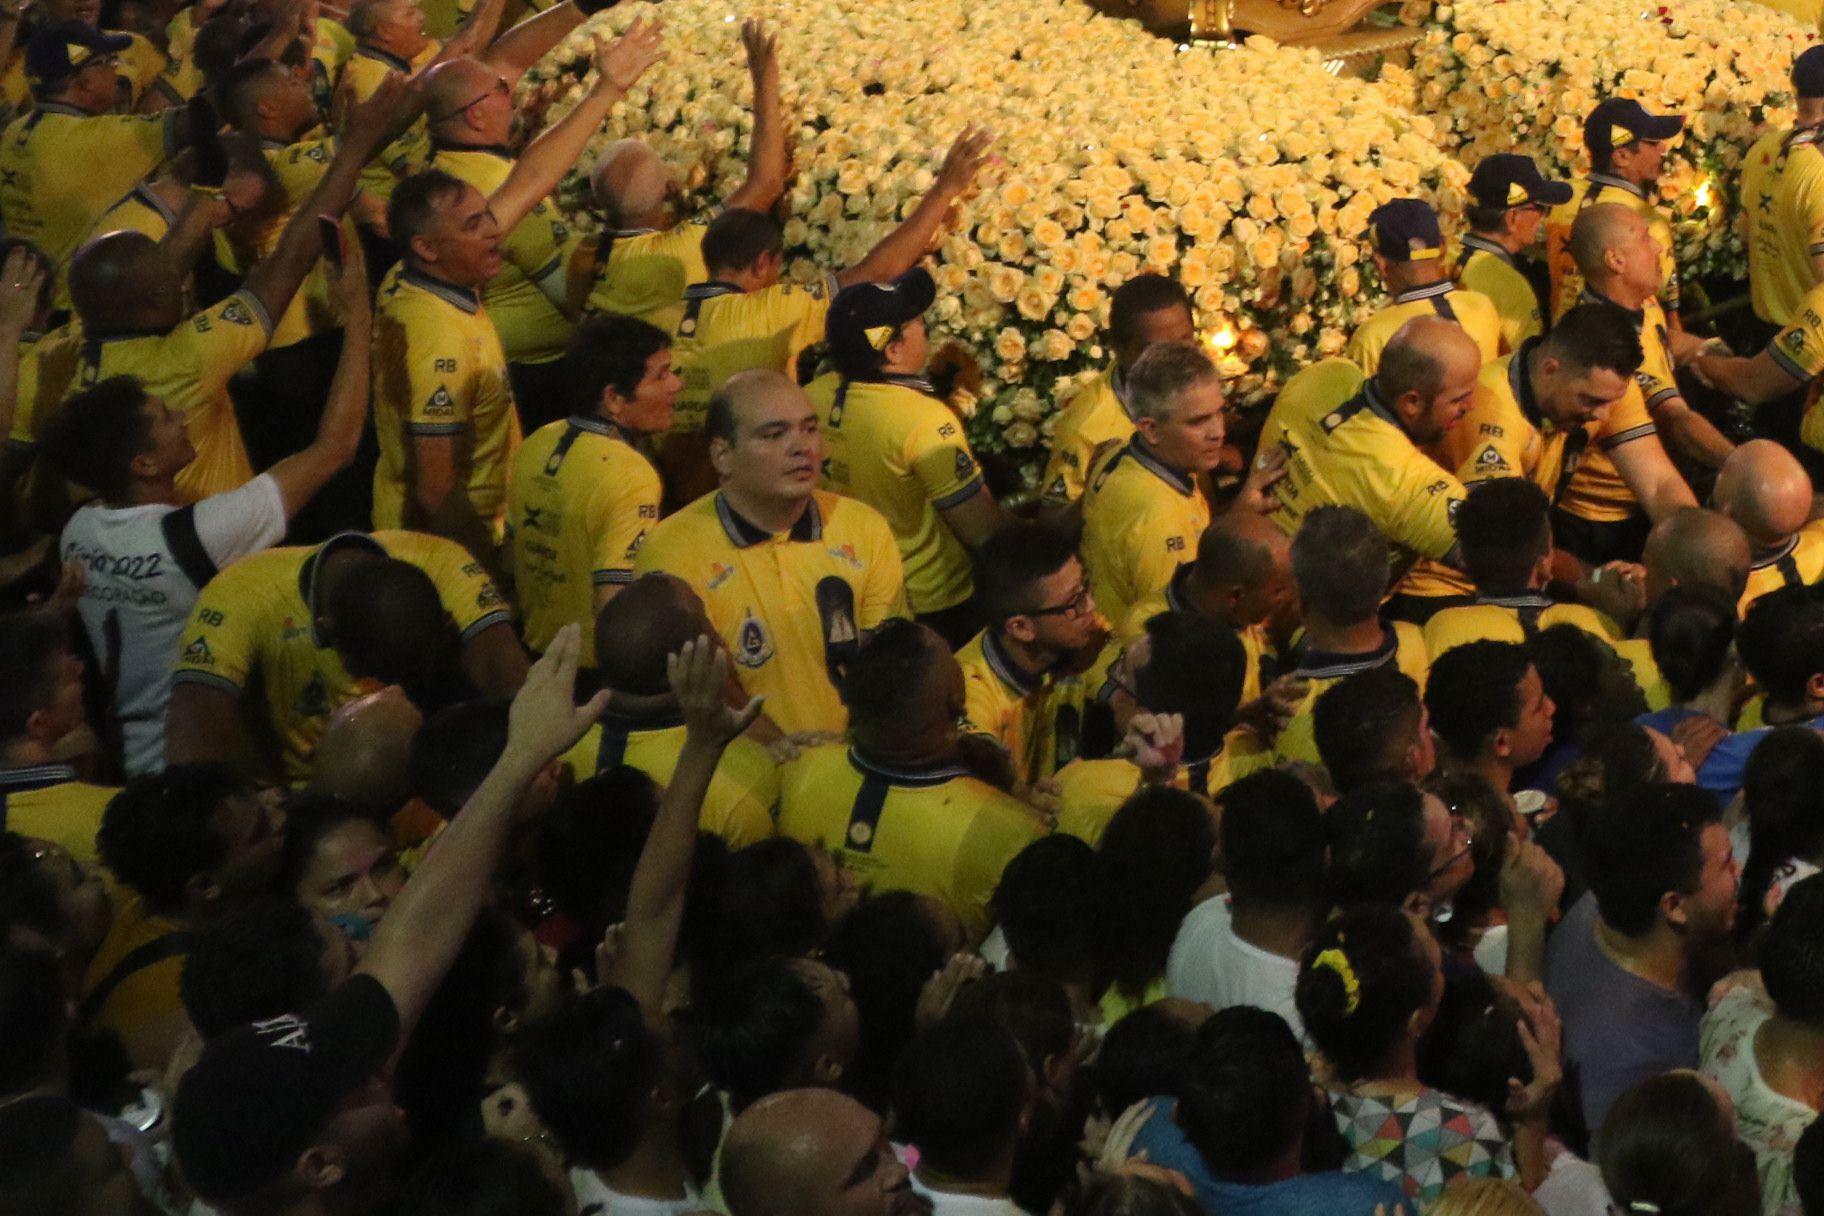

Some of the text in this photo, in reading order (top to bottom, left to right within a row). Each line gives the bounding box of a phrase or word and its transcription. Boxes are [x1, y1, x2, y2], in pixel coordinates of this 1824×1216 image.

[1803, 307, 1822, 328] RB
[433, 358, 458, 374] RB
[1479, 422, 1504, 439] RB
[1165, 536, 1186, 553] RB
[197, 607, 225, 628] RB
